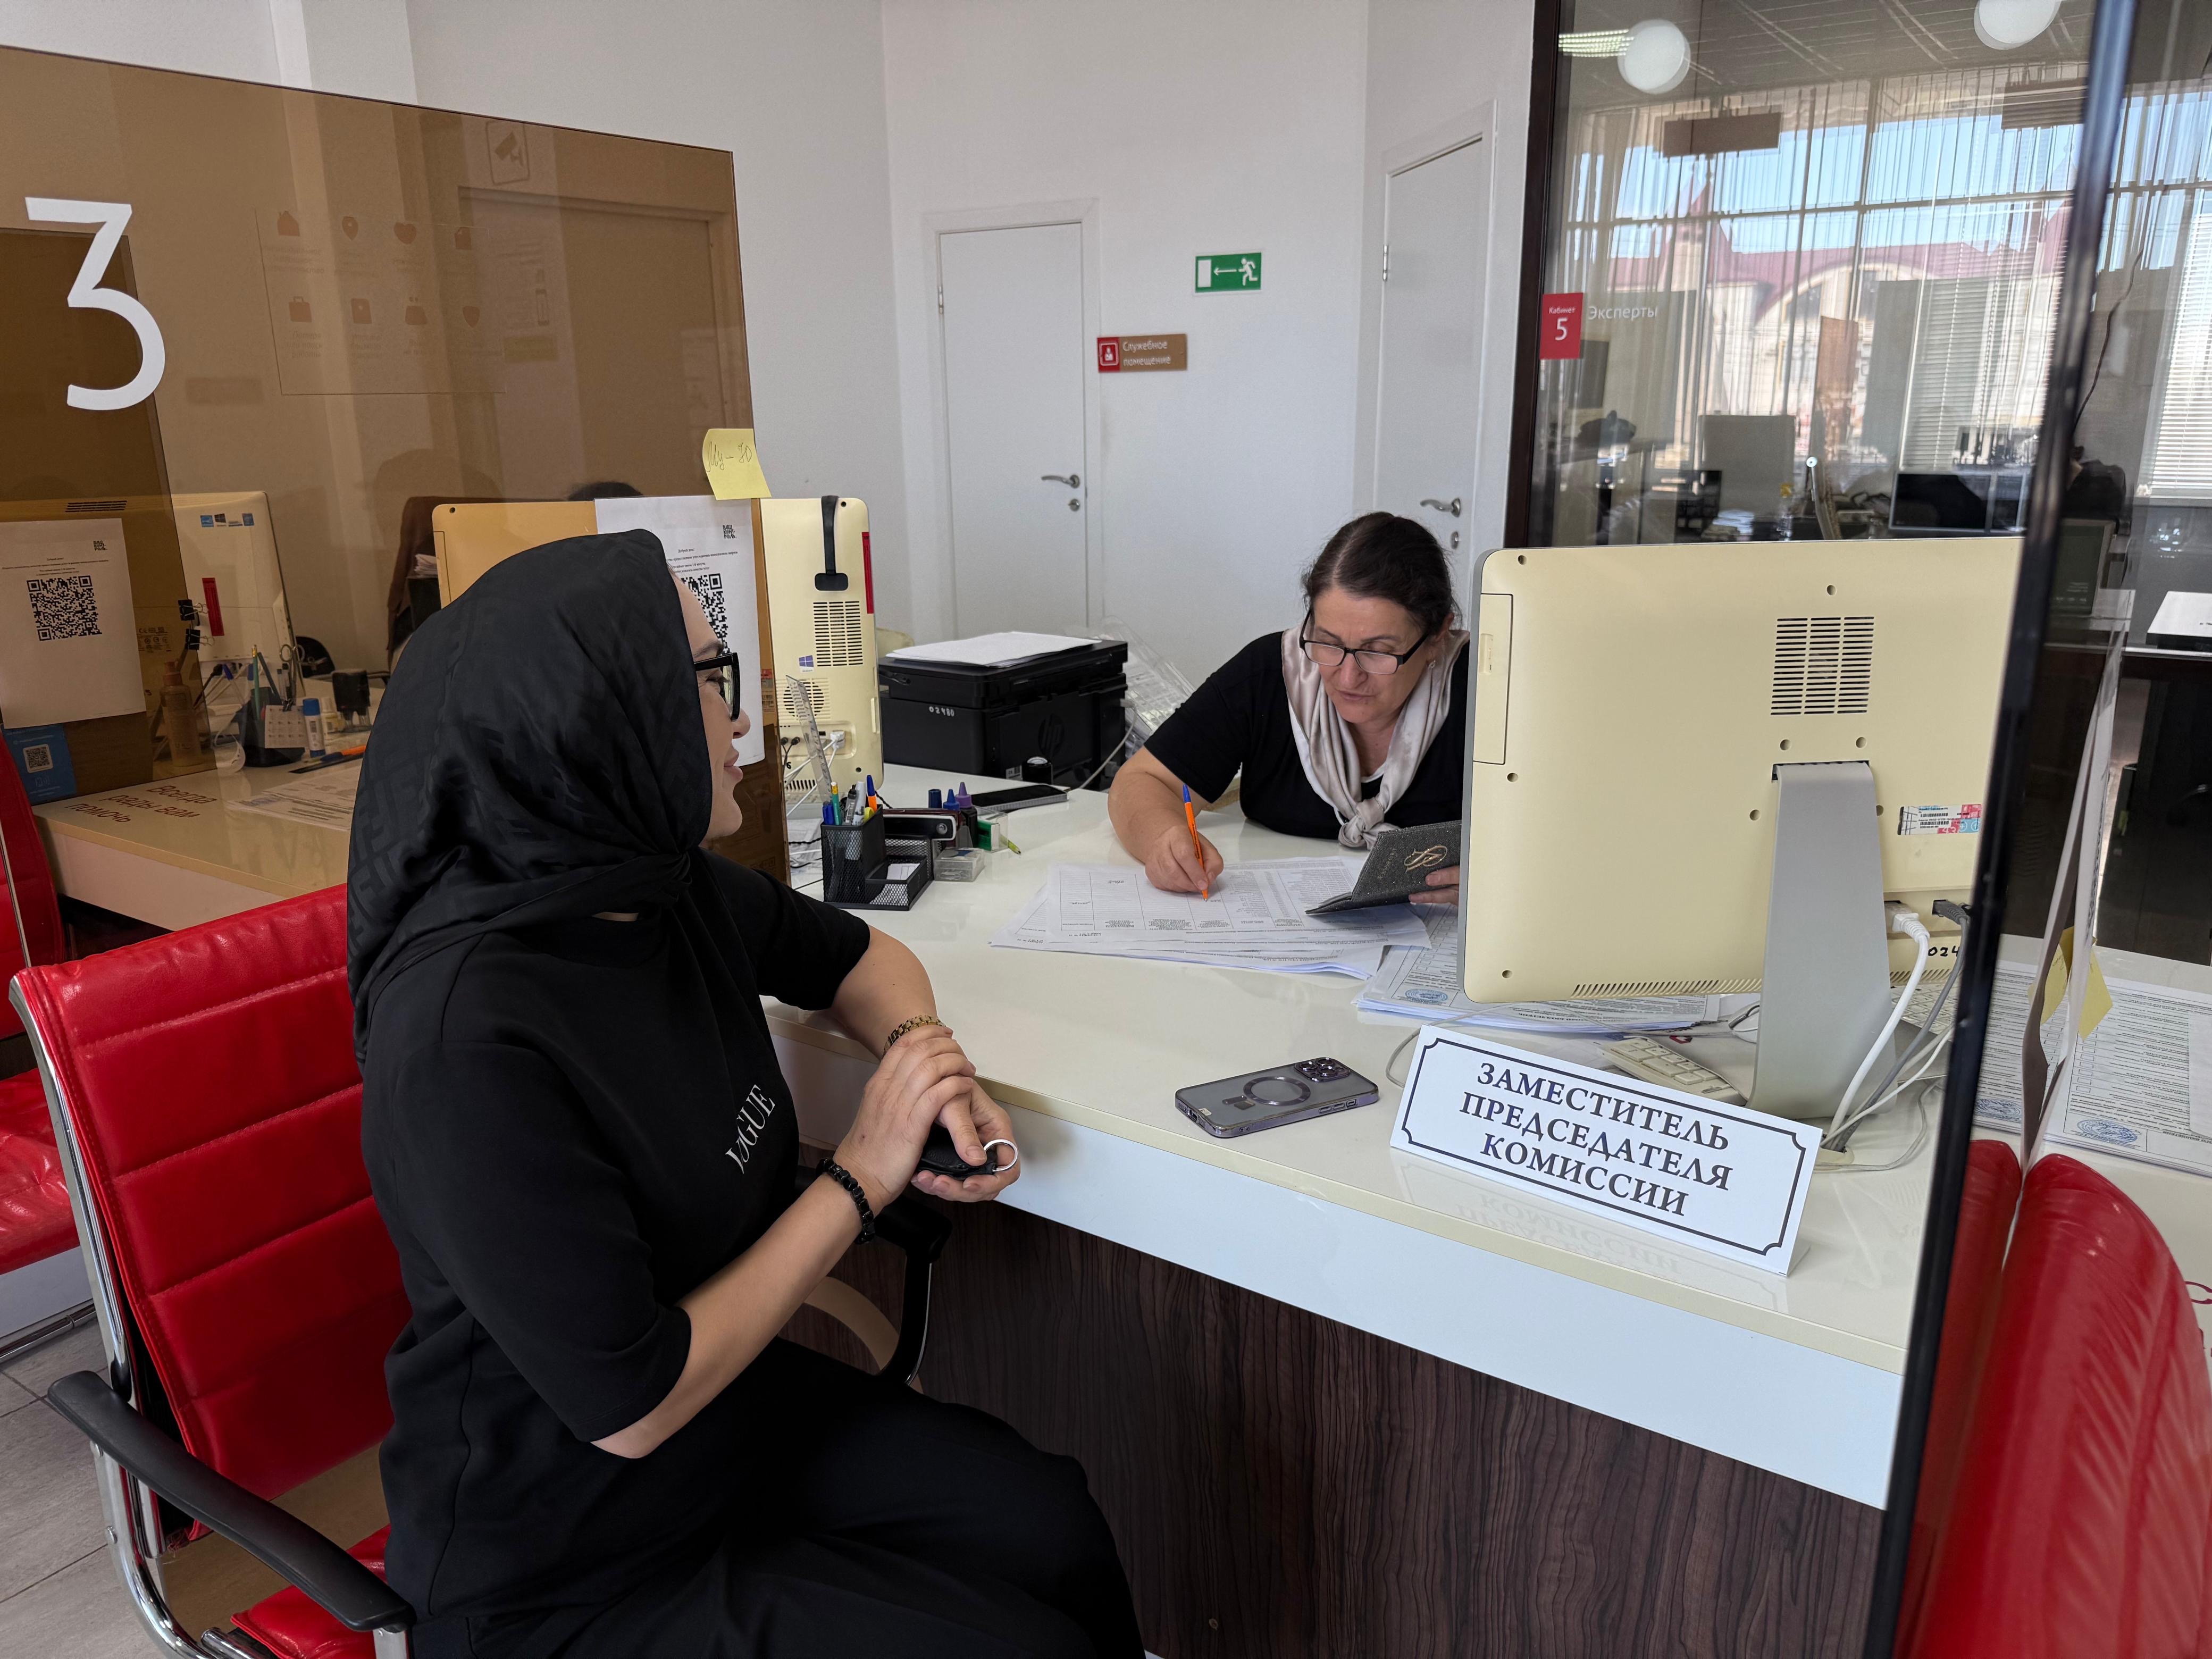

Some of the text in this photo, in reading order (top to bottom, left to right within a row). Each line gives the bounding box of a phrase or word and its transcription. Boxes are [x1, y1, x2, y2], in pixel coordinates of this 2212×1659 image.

[25, 197, 165, 410] 3
[1588, 306, 1657, 321] Эксперты
[1555, 317, 1568, 341] 5
[1122, 340, 1168, 353] Служебное
[1123, 356, 1171, 366] помещение
[146, 785, 217, 804] Всегда
[65, 803, 131, 823] помочь
[99, 795, 200, 818] рады вам
[1478, 1062, 1729, 1150] ЗАМЕСТИТЕЛЬ
[725, 1084, 775, 1174] VOGUE
[1459, 1092, 1733, 1191] ПРЕДСЕДАТЕЛЯ
[1480, 1133, 1689, 1216] КОМИССИИ
